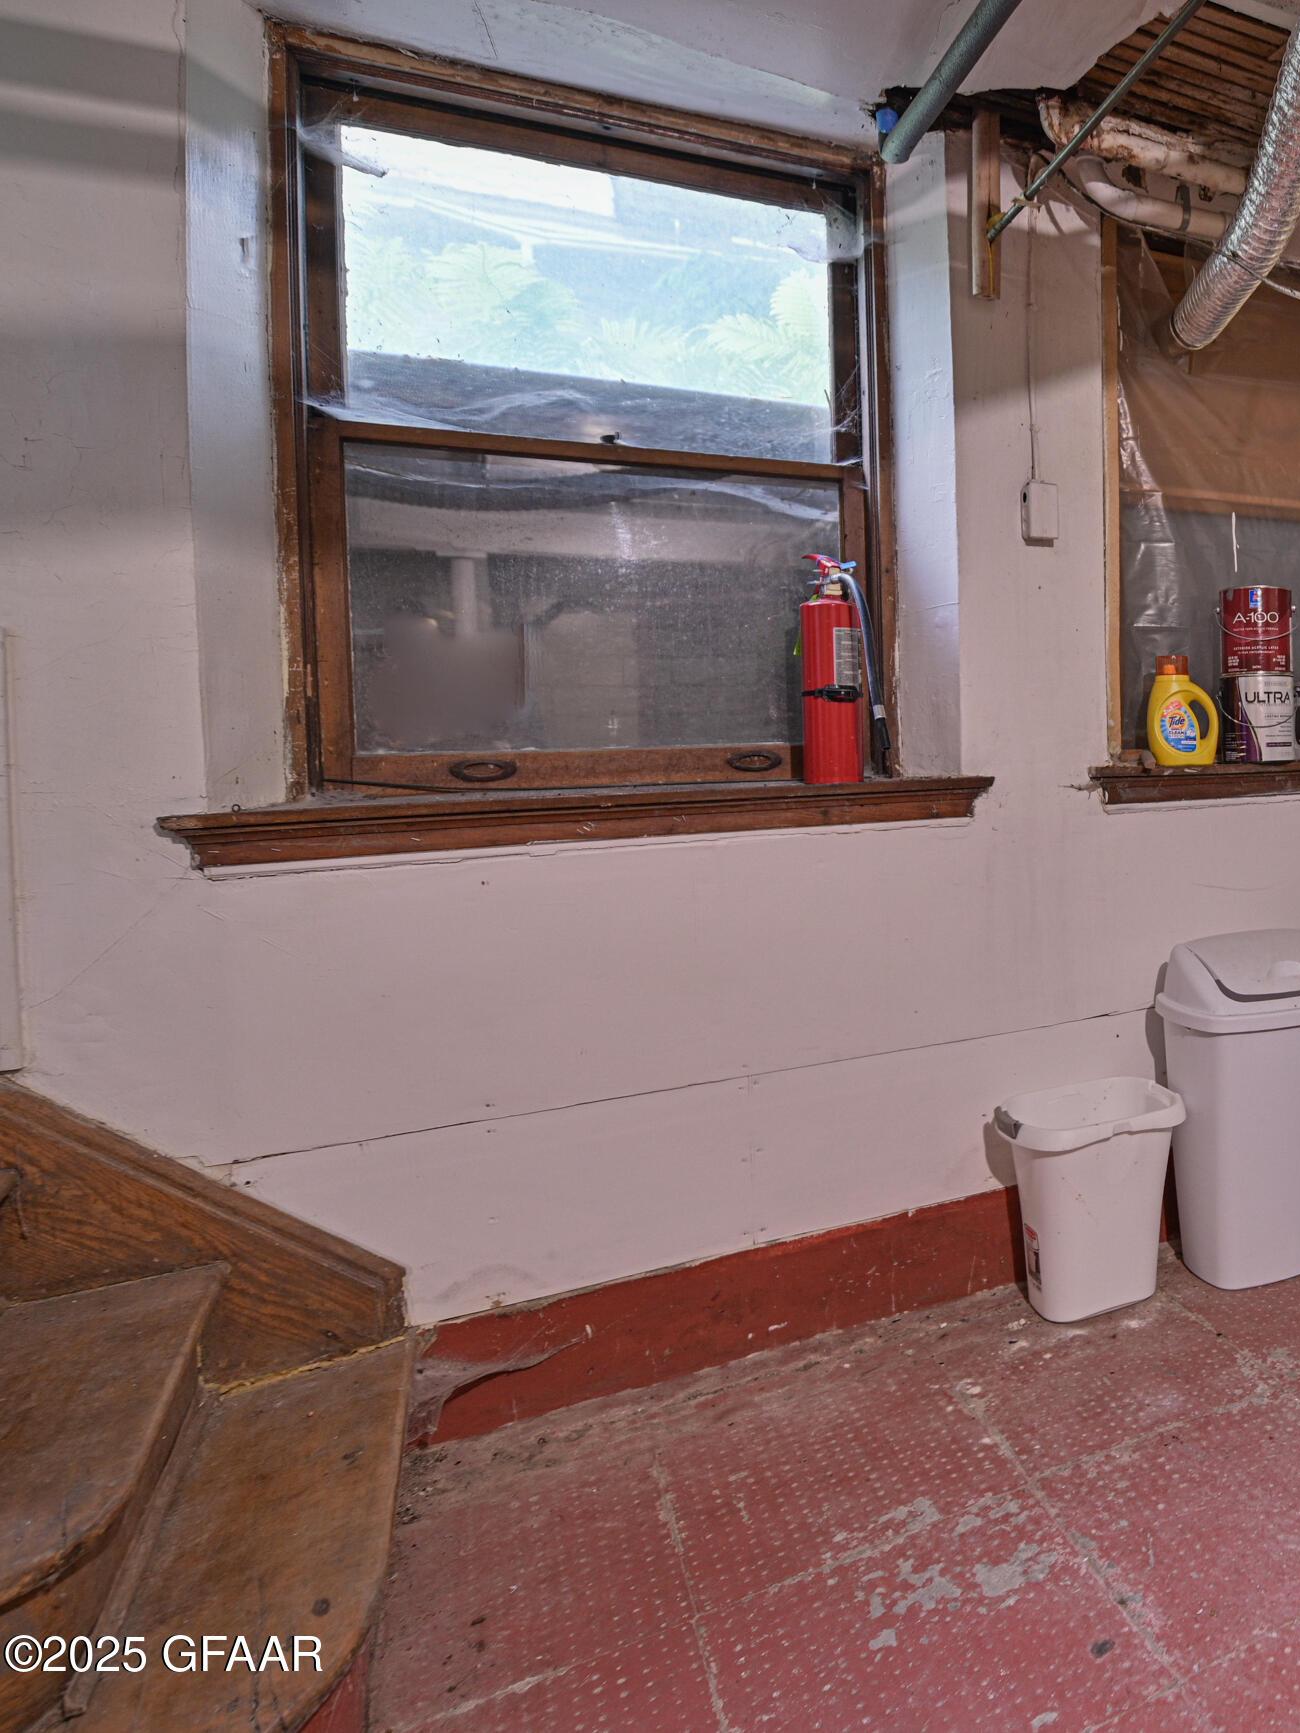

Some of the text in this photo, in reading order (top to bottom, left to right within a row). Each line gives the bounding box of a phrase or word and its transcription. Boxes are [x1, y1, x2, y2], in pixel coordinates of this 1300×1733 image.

[1233, 611, 1279, 624] A-100
[1245, 691, 1291, 704] ULTRA
[1168, 715, 1186, 728] Tide
